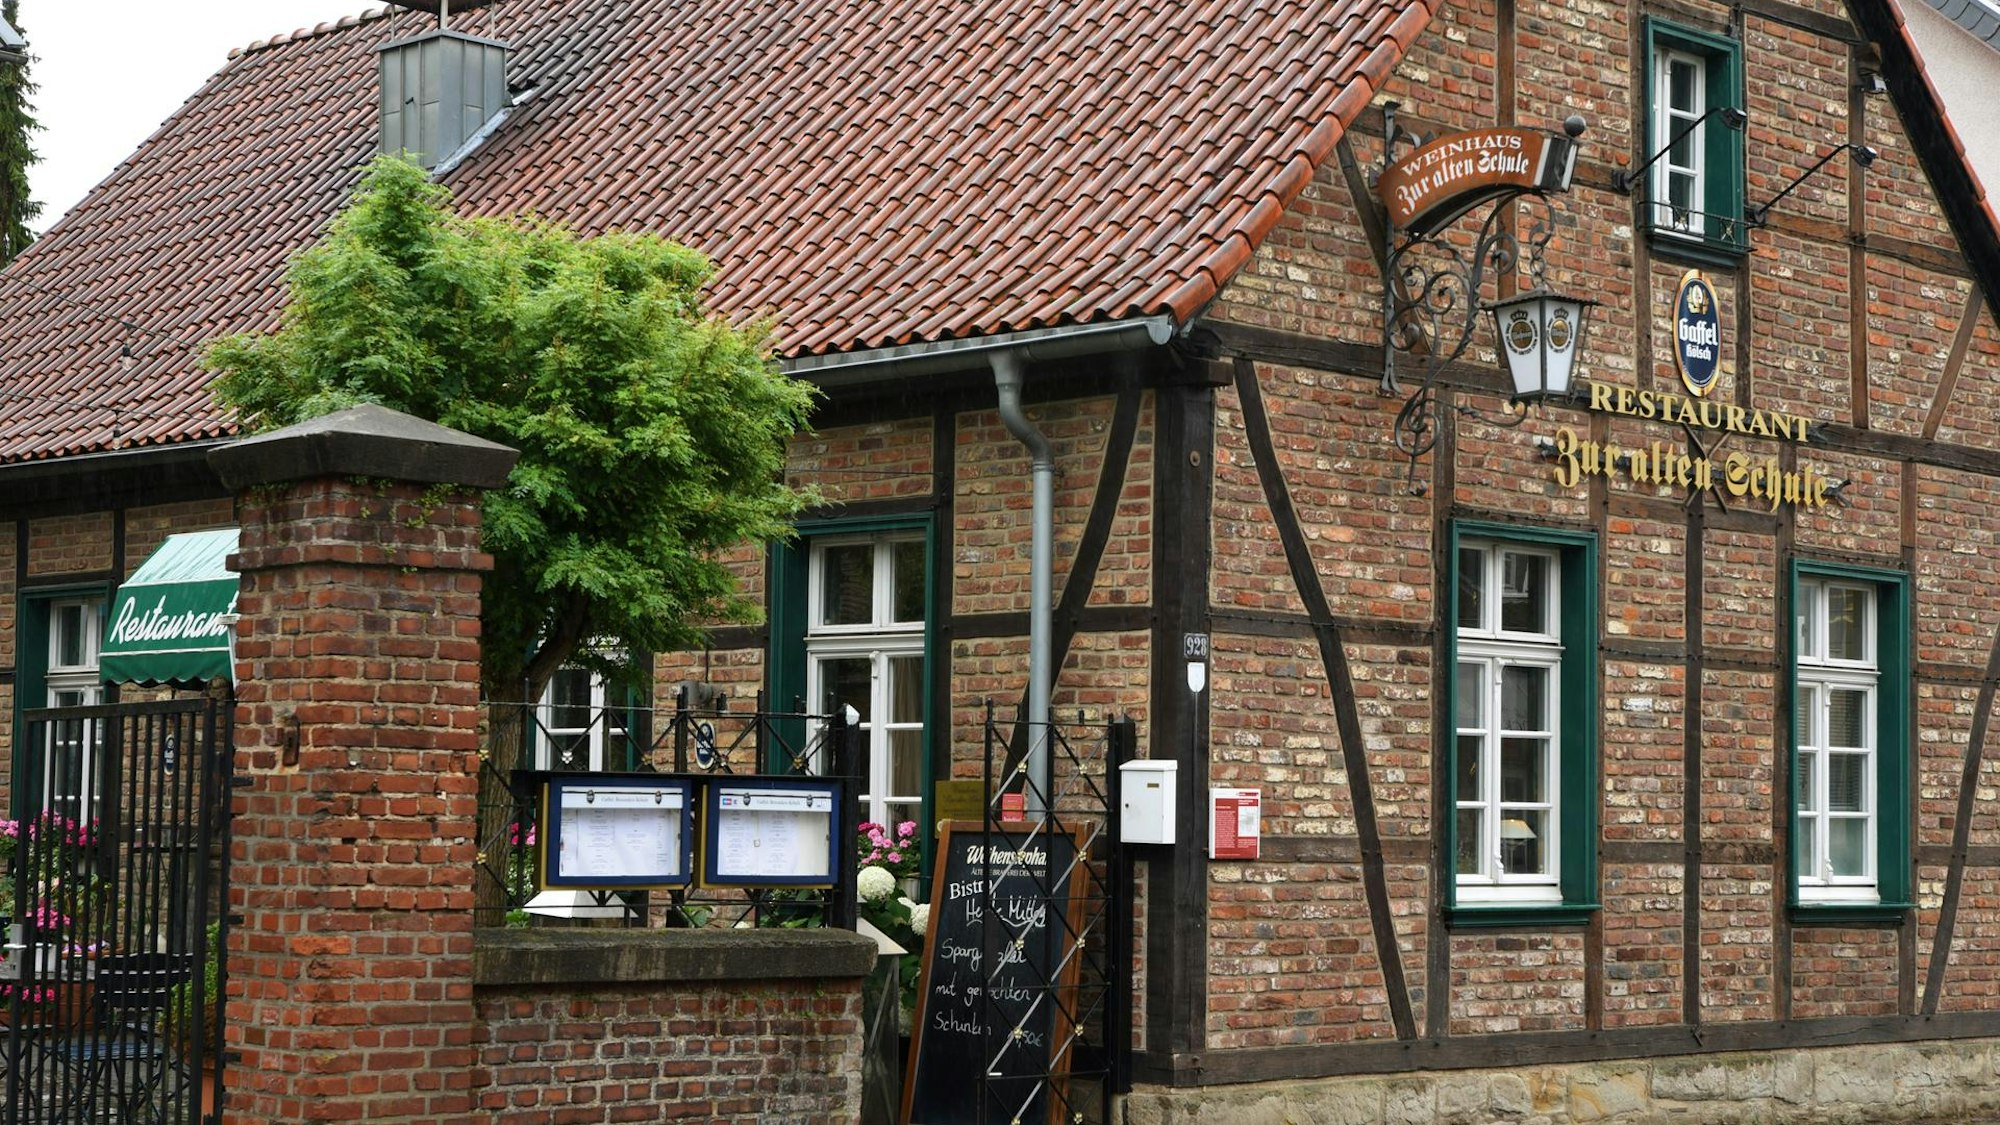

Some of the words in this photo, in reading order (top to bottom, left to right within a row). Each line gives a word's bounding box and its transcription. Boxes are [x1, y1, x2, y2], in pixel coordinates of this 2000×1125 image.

[1401, 134, 1522, 177] WEINHAUS
[1396, 176, 1430, 216] Zur
[1433, 157, 1474, 187] alten
[1477, 150, 1530, 177] Schule
[1679, 318, 1718, 346] Gaffel
[1686, 343, 1712, 361] Kölsch
[1589, 382, 1812, 443] RESTAURANT
[1553, 426, 1624, 489] Zur
[1630, 440, 1716, 492] alten
[1724, 451, 1829, 513] Schule
[109, 590, 240, 645] Restaurant
[1186, 636, 1207, 656] 928
